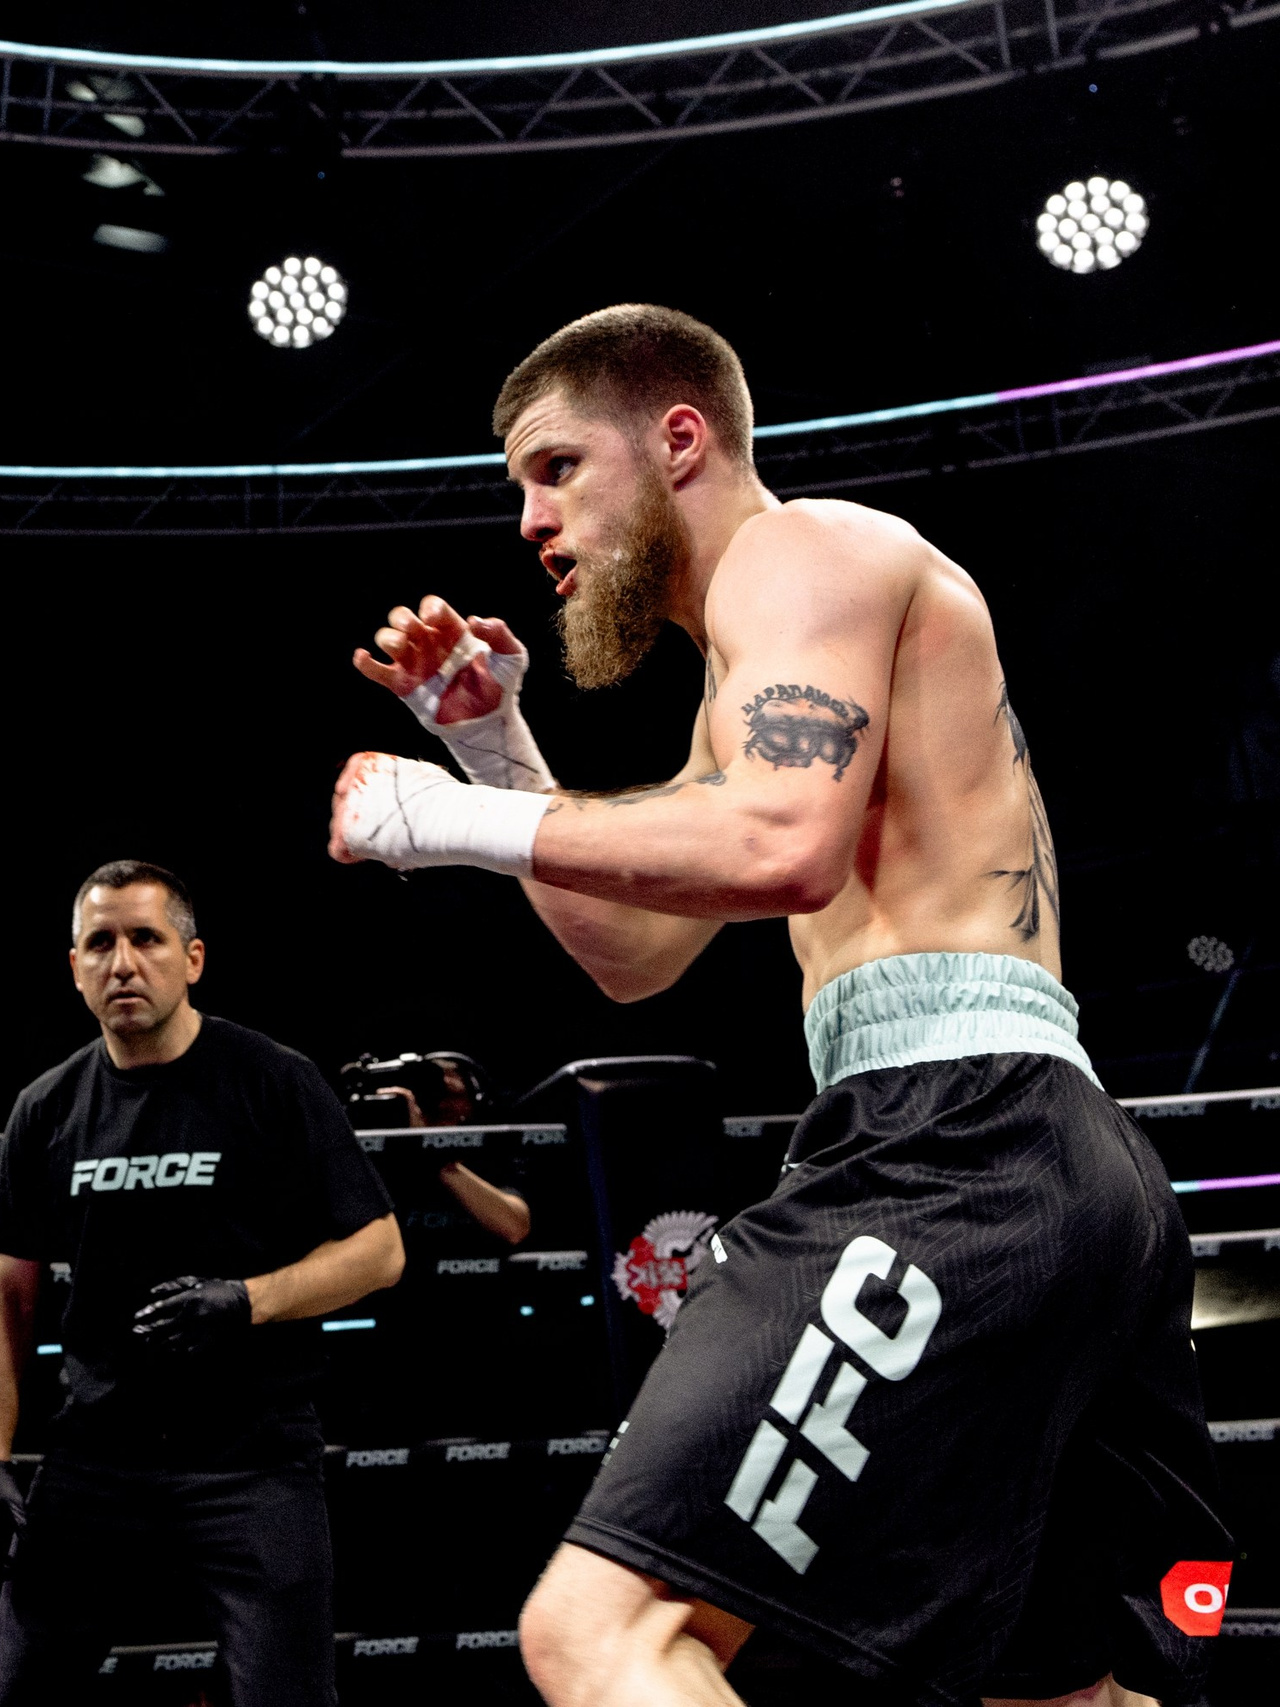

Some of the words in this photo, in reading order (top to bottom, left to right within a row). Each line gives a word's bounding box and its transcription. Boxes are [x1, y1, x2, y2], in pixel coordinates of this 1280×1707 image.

[70, 1151, 222, 1197] FORCE
[437, 1258, 500, 1275] FORCE
[346, 1447, 410, 1467] FORCE
[445, 1442, 511, 1462] FORCE
[153, 1651, 217, 1671] FORCE
[353, 1636, 420, 1657] FORCE
